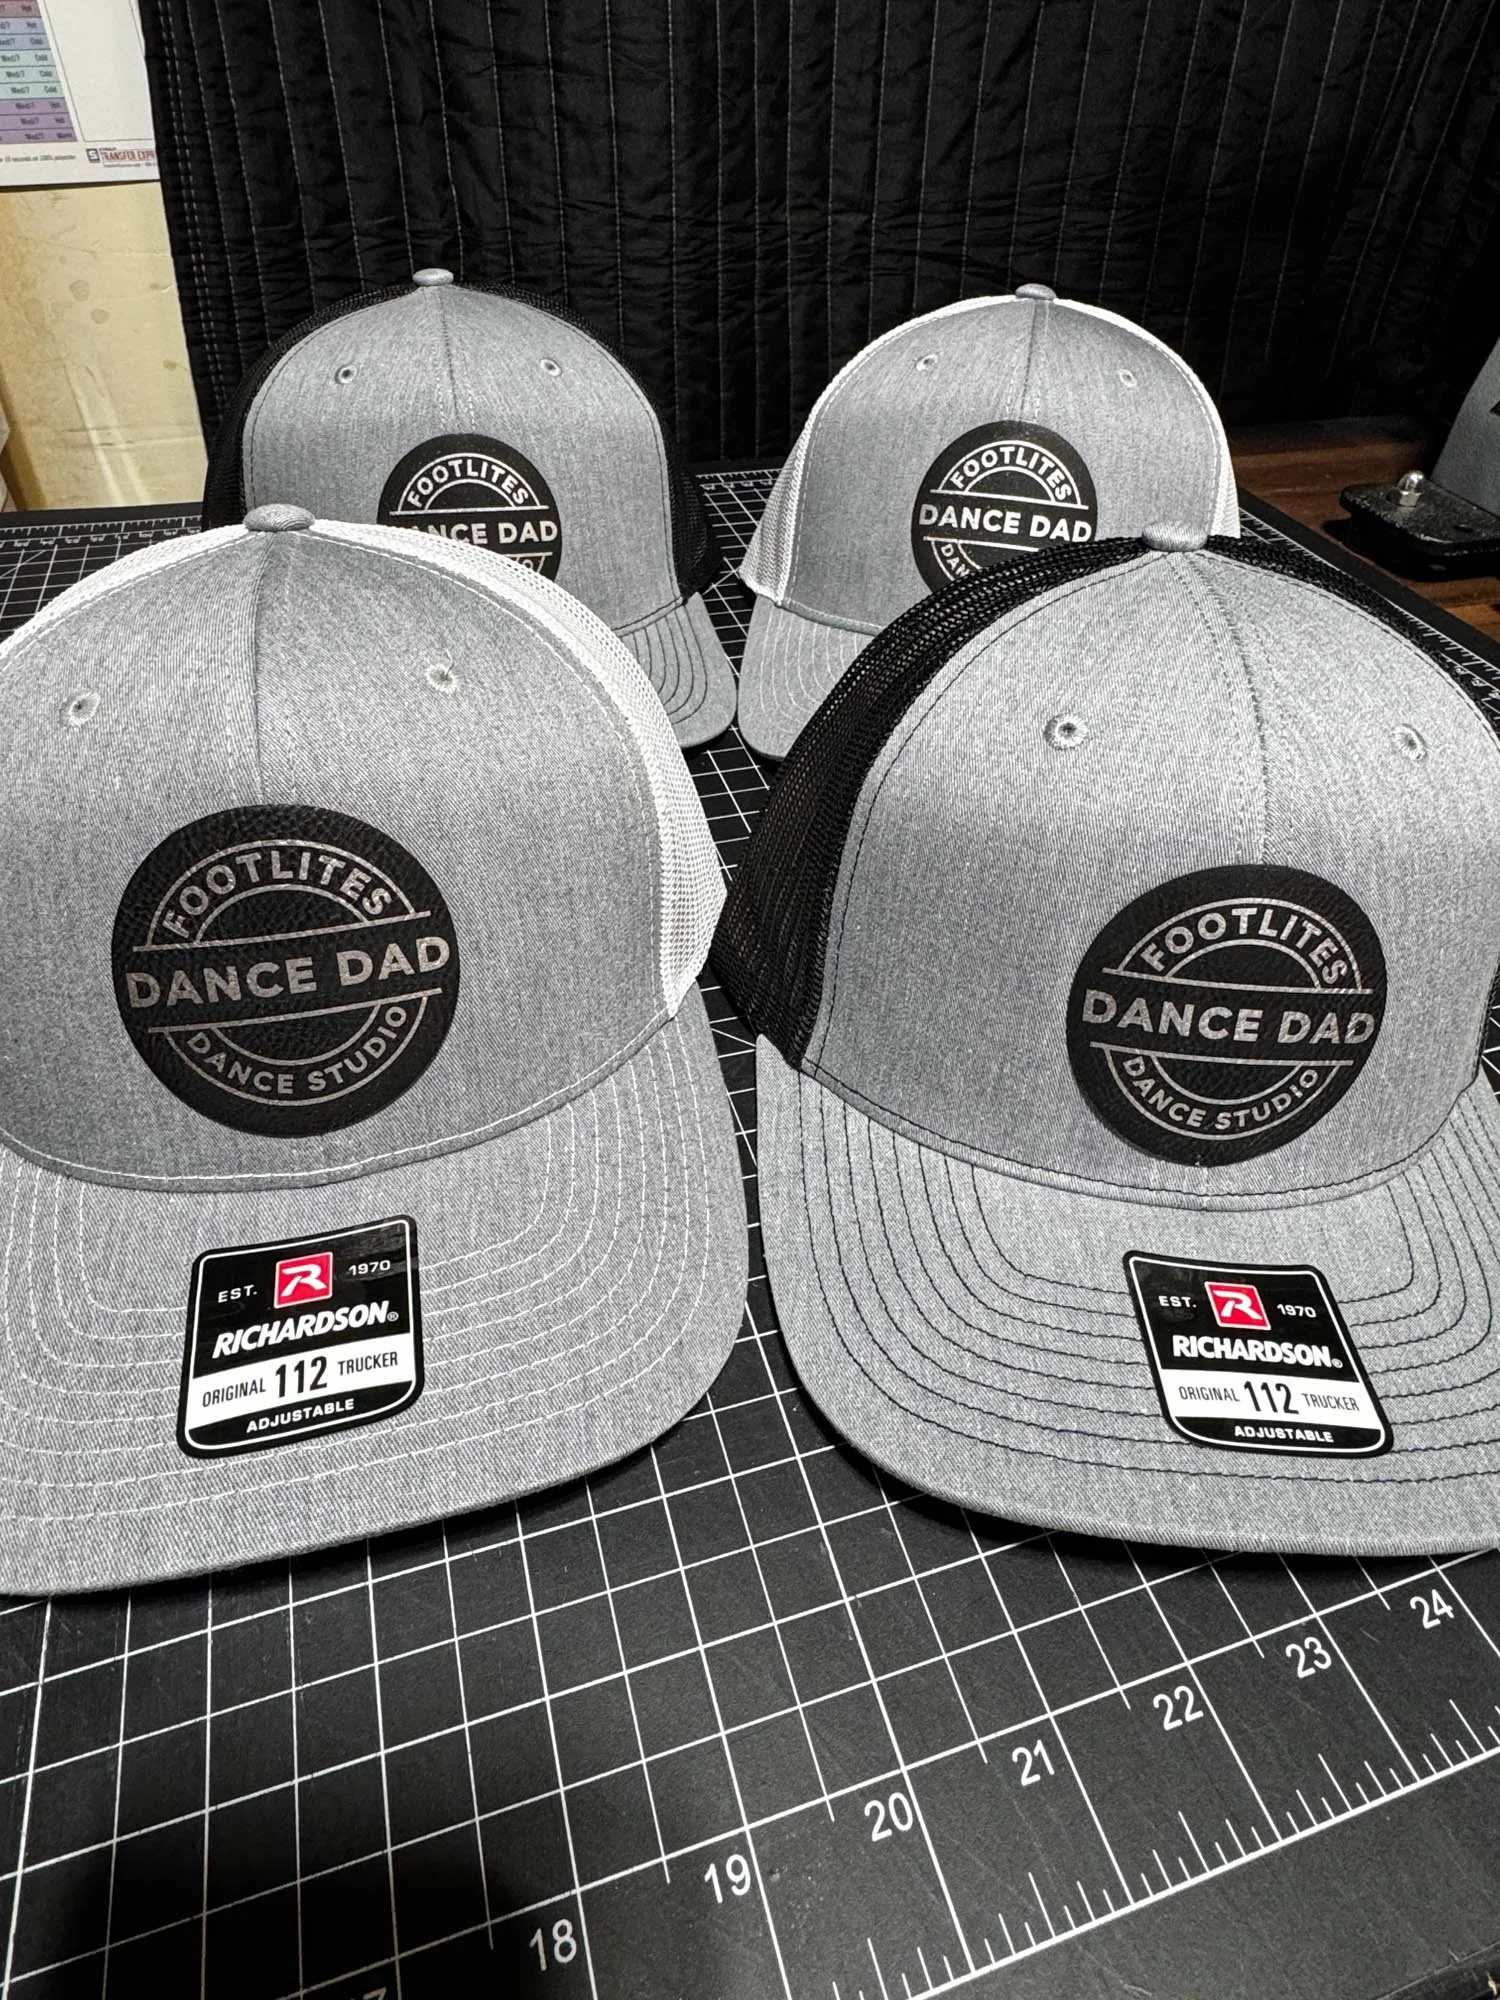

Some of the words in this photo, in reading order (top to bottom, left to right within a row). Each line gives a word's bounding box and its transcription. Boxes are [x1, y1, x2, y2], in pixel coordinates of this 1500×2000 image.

[407, 459, 529, 508] FOOTLITES
[950, 446, 1072, 501] FOOTLITES
[411, 523, 488, 545] NCE
[498, 520, 558, 544] DAD
[919, 503, 1022, 535] DANCE
[1029, 514, 1092, 543] DAD
[941, 543, 970, 578] DAN
[162, 850, 392, 938] FOOTLITES
[1140, 907, 1348, 985] FOOTLITES
[125, 956, 317, 1009] DANCE
[336, 936, 450, 986] DAD
[1082, 989, 1264, 1042] DANCE
[1277, 1010, 1376, 1045] DAD
[187, 1032, 294, 1094] DANCE
[308, 1006, 407, 1092] STUDIO
[1123, 1055, 1206, 1128] DANCE
[1215, 1069, 1319, 1130] STUDIO
[217, 1284, 258, 1303] EST.
[348, 1259, 391, 1276] 1970
[1158, 1295, 1197, 1308] EST.
[1277, 1303, 1317, 1318] 1970
[202, 1378, 266, 1408] ORIGINAL
[275, 1355, 328, 1398] 112
[337, 1351, 398, 1376] TRUCKER
[1178, 1386, 1240, 1402] ORIGINAL
[1244, 1380, 1299, 1414] 112
[1302, 1392, 1360, 1411] TRUCKER
[246, 1398, 355, 1434] ADJUSTABLE
[1234, 1425, 1334, 1443] ADJUSTABLE
[1411, 1588, 1454, 1630] 24
[1286, 1636, 1332, 1678] 23
[1153, 1685, 1204, 1731] 22
[1012, 1739, 1055, 1785] 21
[864, 1791, 914, 1841] 20
[704, 1854, 751, 1903] 19
[529, 1918, 577, 1971] 18
